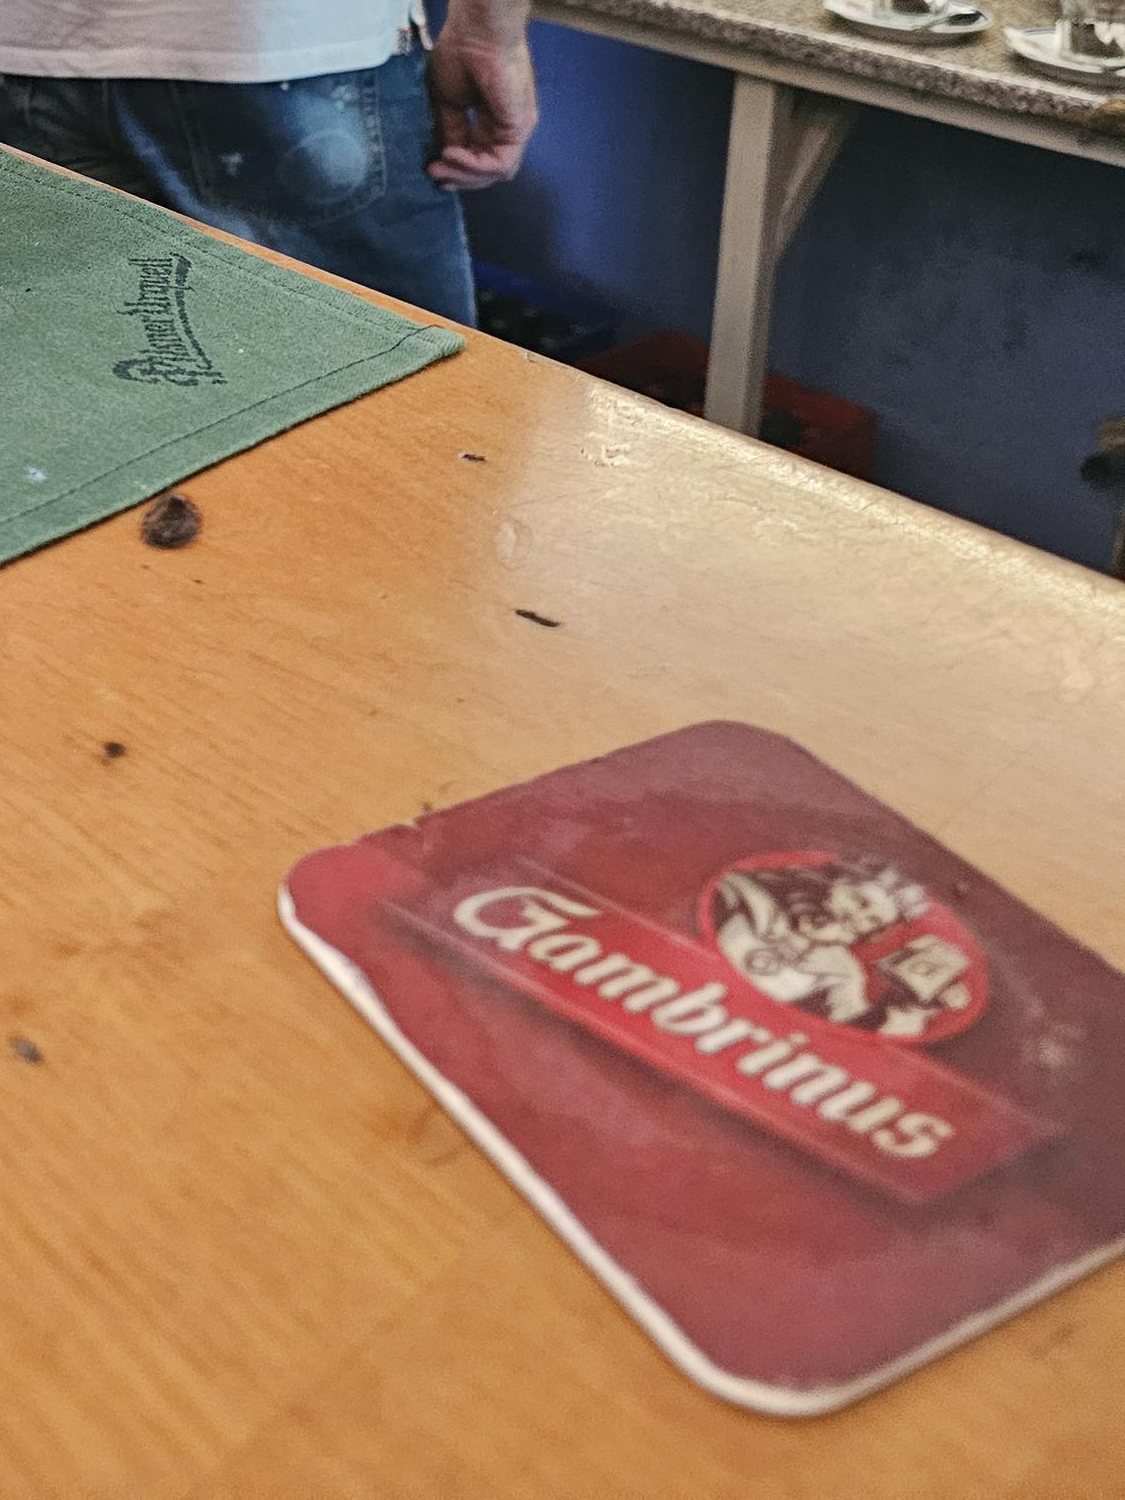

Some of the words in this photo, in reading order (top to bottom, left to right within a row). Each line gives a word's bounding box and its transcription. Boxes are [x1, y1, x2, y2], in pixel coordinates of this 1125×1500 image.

[116, 257, 196, 316] Urquell
[113, 316, 227, 386] Pilsner
[453, 886, 953, 1158] Gambrinus
